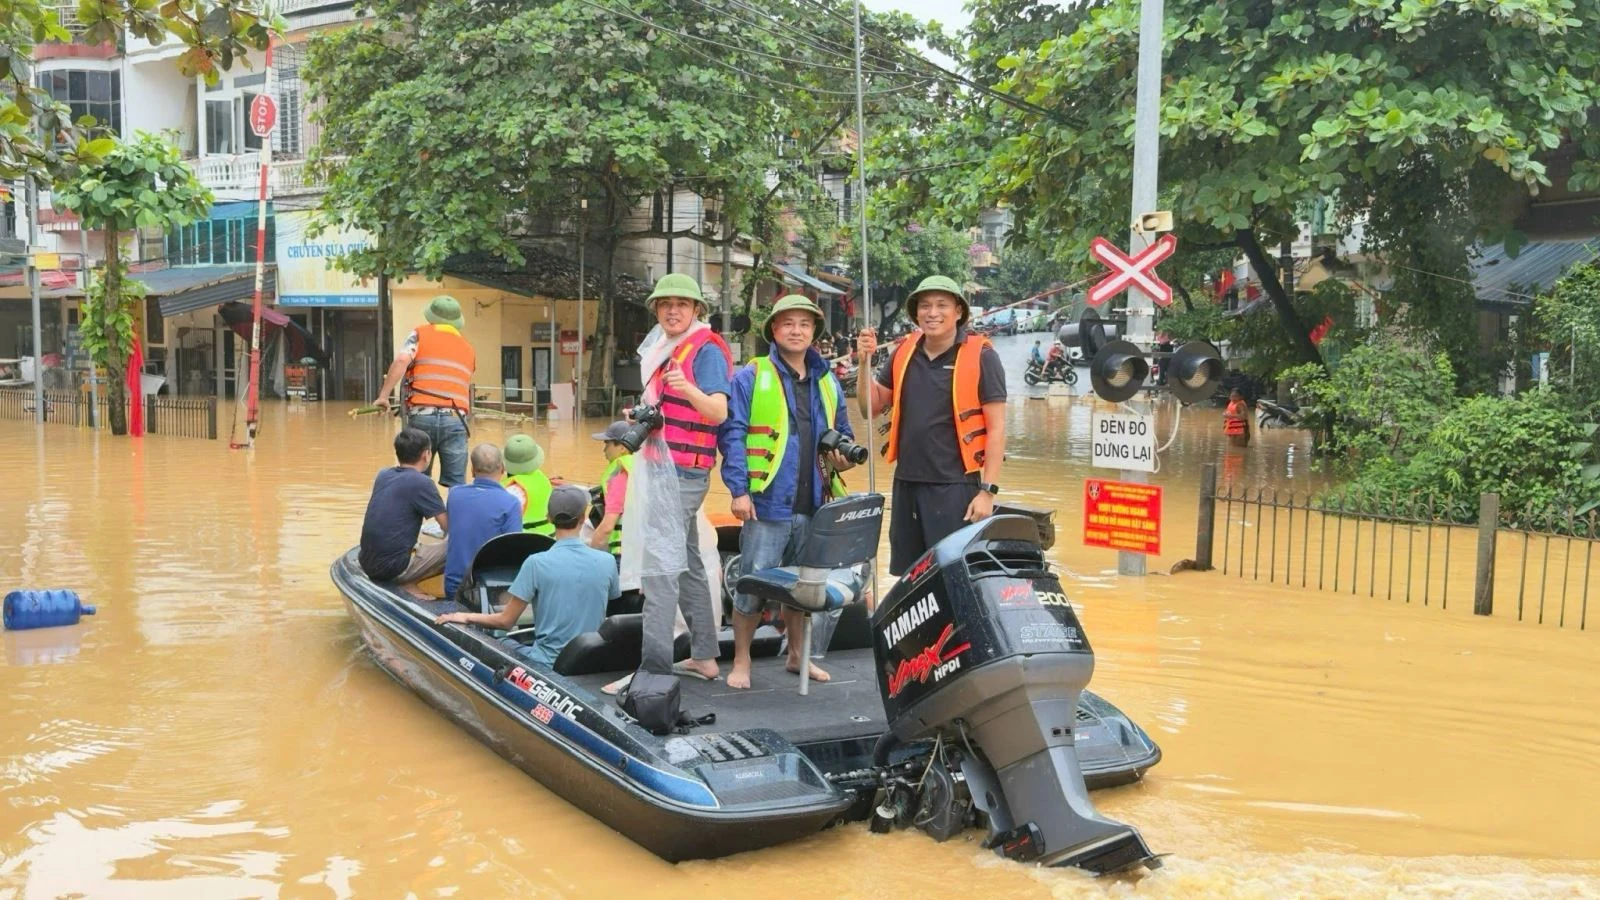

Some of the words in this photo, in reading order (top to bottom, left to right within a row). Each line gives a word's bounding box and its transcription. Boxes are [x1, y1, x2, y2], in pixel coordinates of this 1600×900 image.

[256, 95, 268, 133] STOP
[1100, 415, 1126, 435] ĐÈN
[1129, 415, 1147, 436] ĐỎ
[1094, 438, 1129, 459] DỪNG
[1132, 445, 1151, 462] LẠI
[834, 506, 883, 523] JAVELIN
[1035, 591, 1070, 607] 200
[883, 591, 940, 650] YAMAHA
[933, 656, 961, 682] HPDI
